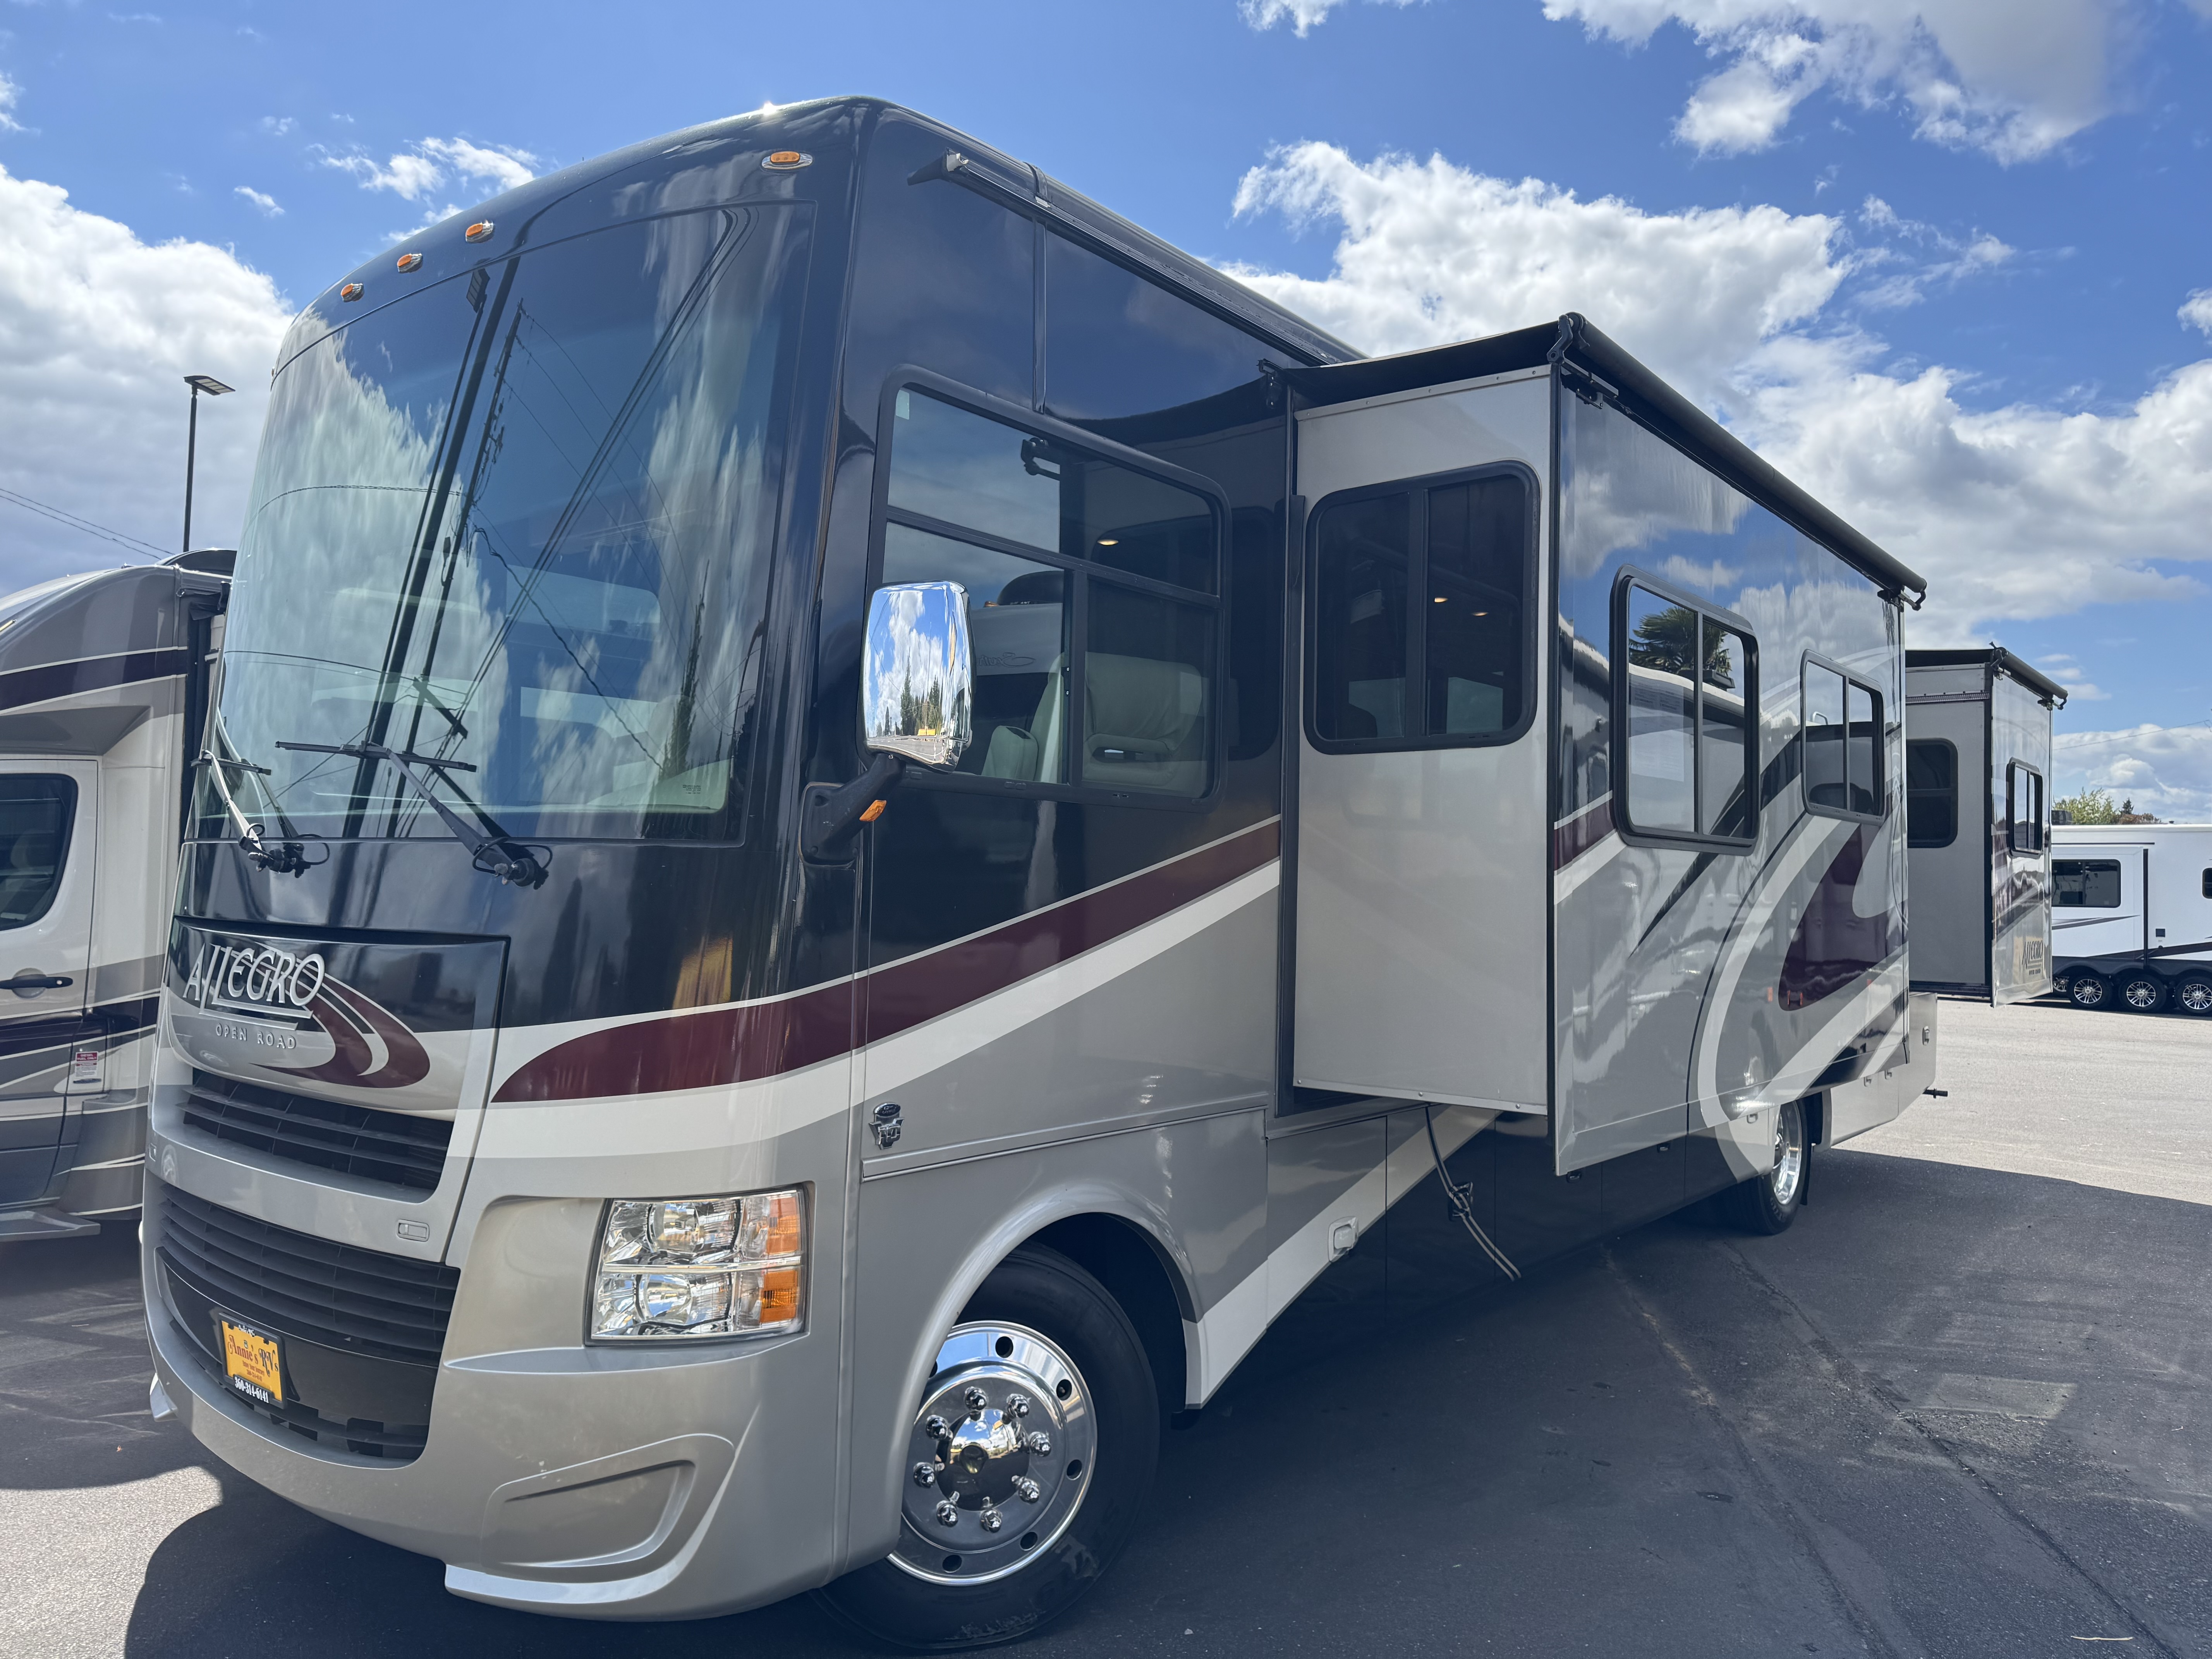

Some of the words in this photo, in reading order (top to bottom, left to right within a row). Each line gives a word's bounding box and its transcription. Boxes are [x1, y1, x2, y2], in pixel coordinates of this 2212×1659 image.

[183, 942, 325, 1018] ALLEGRO
[215, 1023, 247, 1041] OPEN
[257, 1031, 296, 1049] ROAD
[228, 1334, 258, 1364] Annie's
